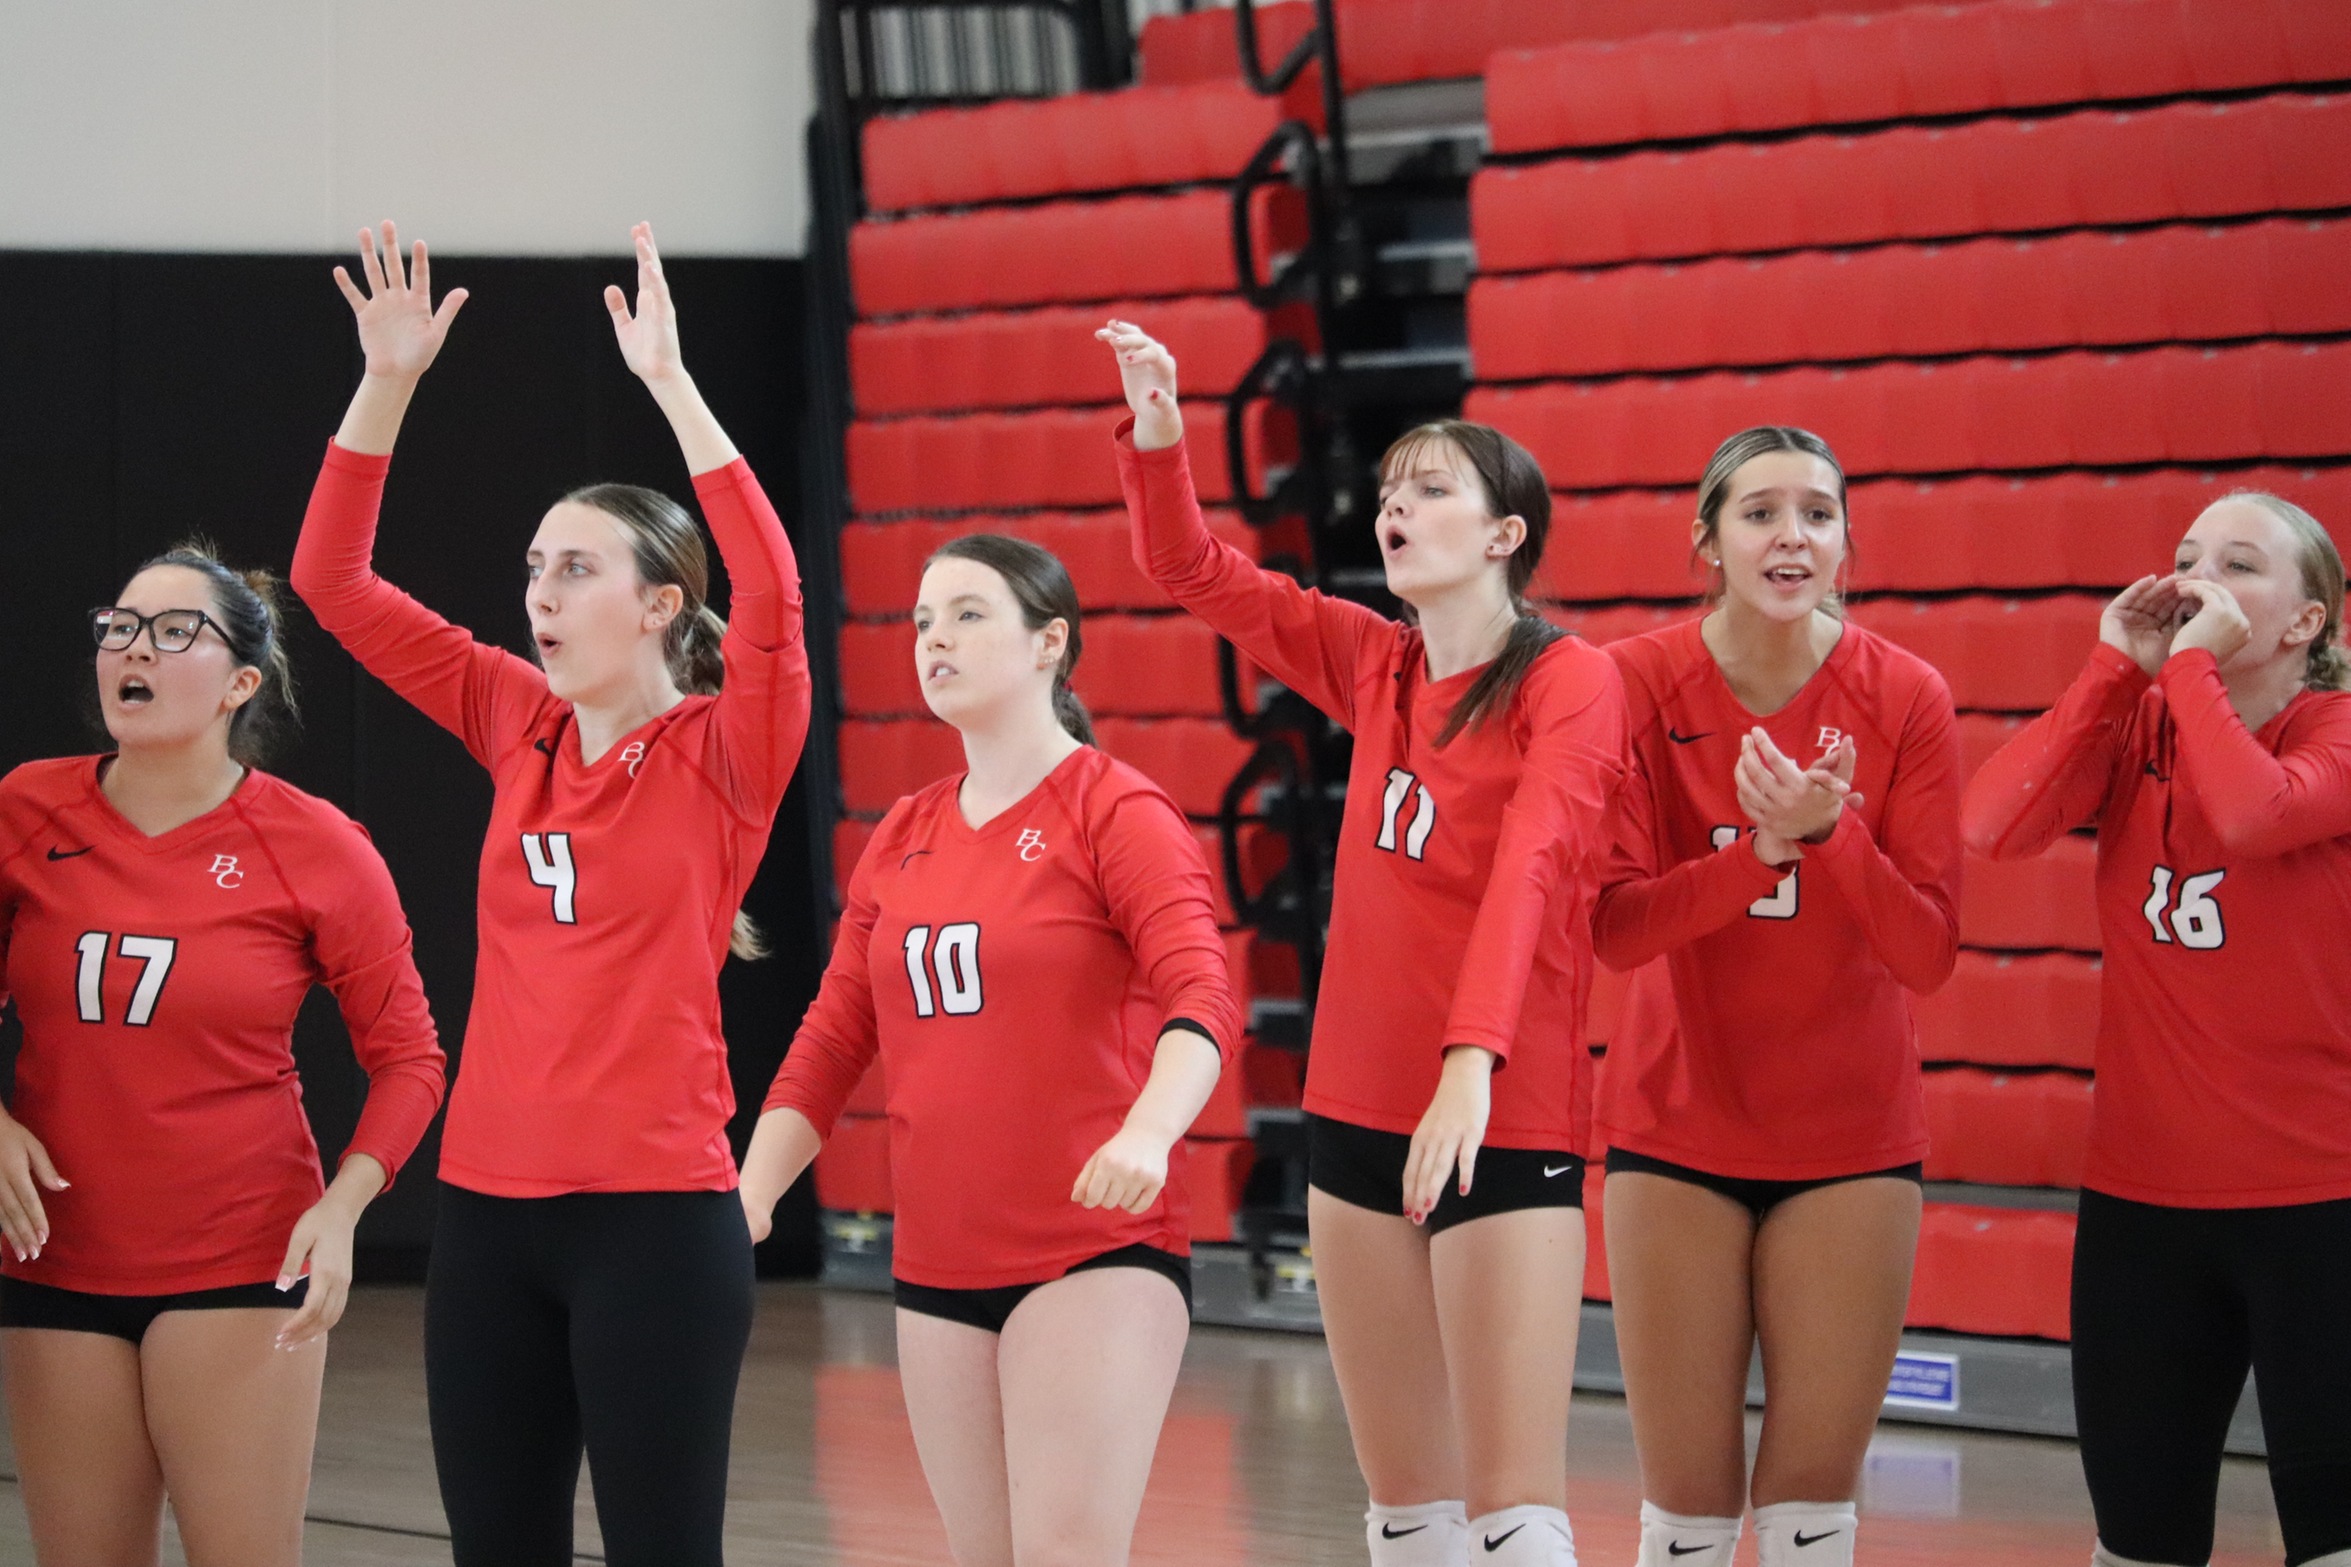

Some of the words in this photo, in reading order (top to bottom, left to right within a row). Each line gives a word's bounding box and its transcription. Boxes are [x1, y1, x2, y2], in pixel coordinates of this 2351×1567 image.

[1016, 828, 1046, 862] BC
[1376, 766, 1435, 861] 11
[207, 853, 244, 889] BC
[521, 832, 577, 925] 4
[2142, 866, 2226, 949] 16
[76, 931, 178, 1027] 17
[904, 922, 983, 1017] 10
